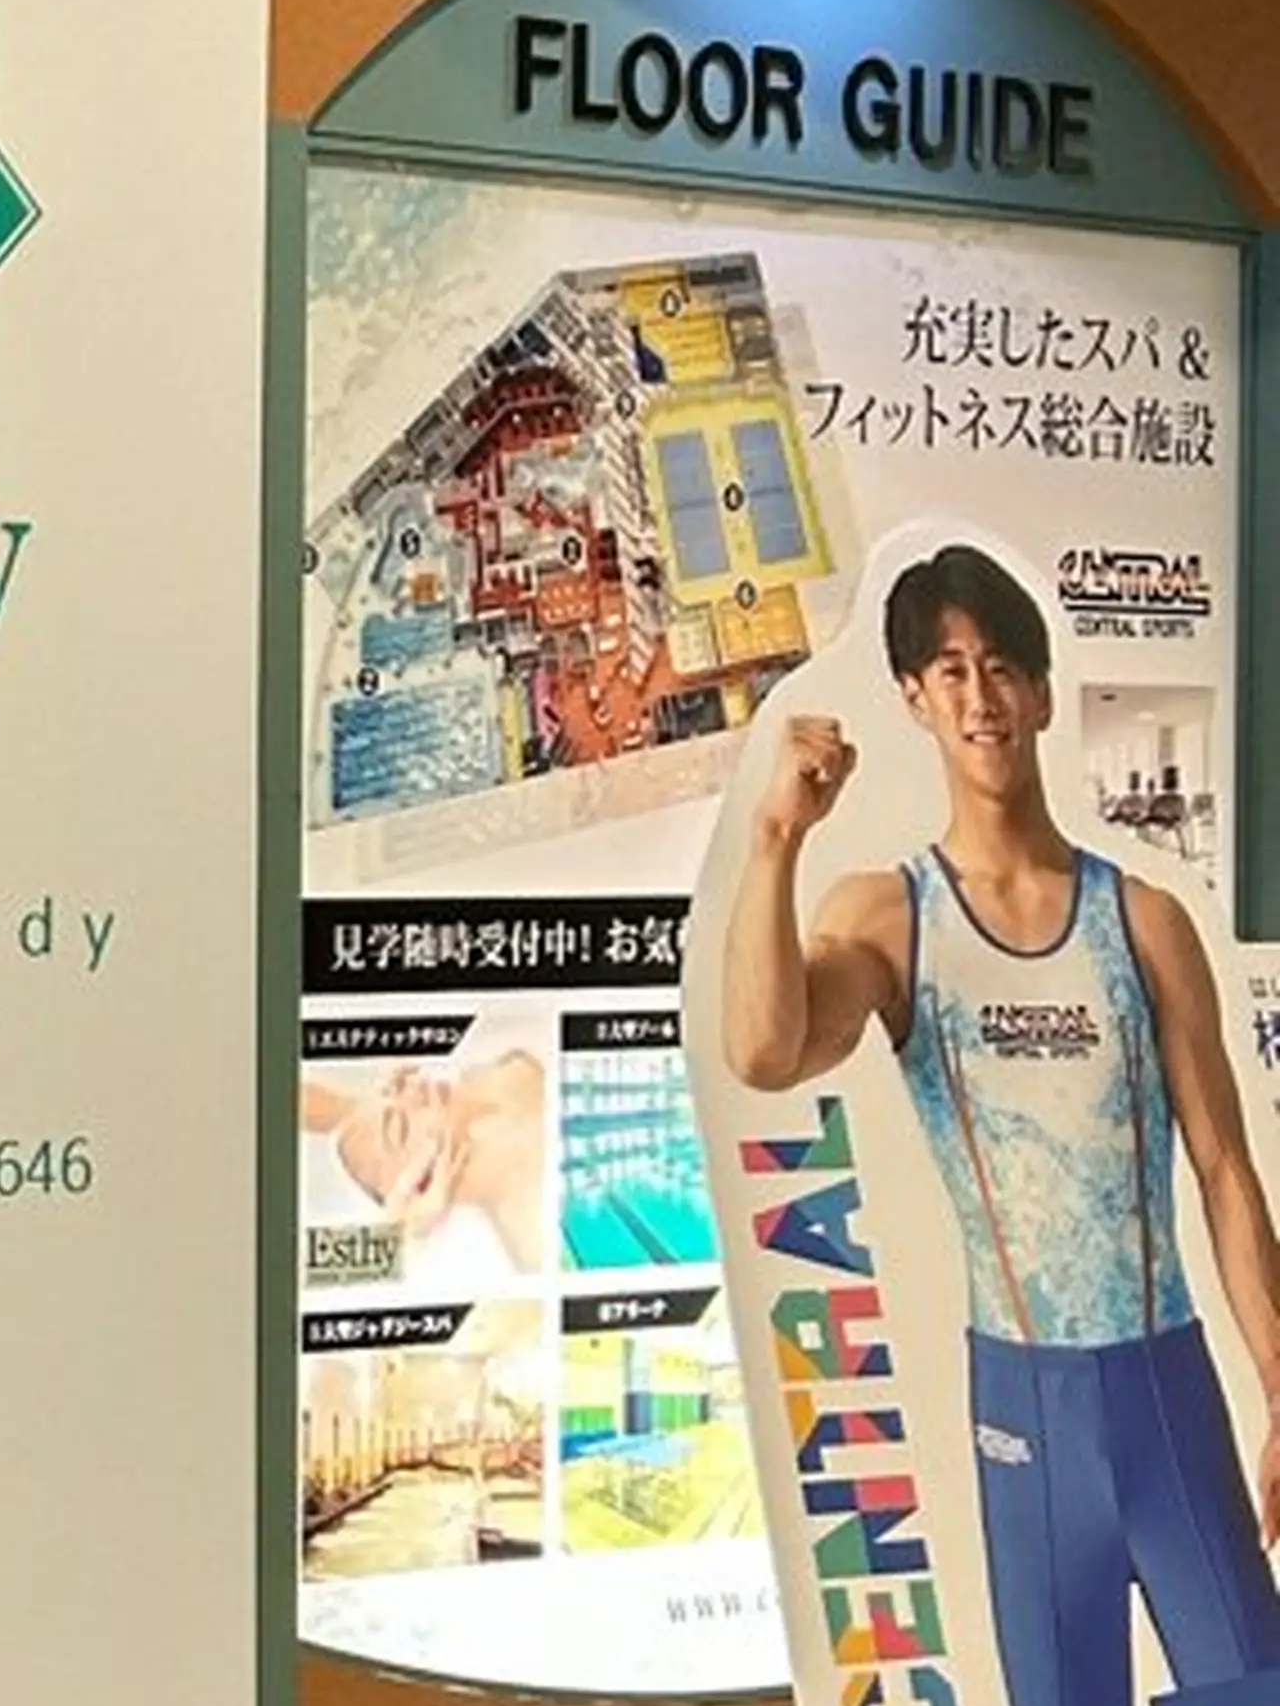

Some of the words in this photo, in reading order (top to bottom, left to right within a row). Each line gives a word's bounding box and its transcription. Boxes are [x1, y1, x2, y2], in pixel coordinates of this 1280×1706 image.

[514, 15, 805, 149] FLOOR
[842, 57, 1096, 179] GUIDE
[902, 295, 1160, 372] 充実したスパ
[1178, 326, 1210, 381] &
[805, 383, 1215, 467] フィットネス総合施設
[306, 1226, 398, 1278] Esthy
